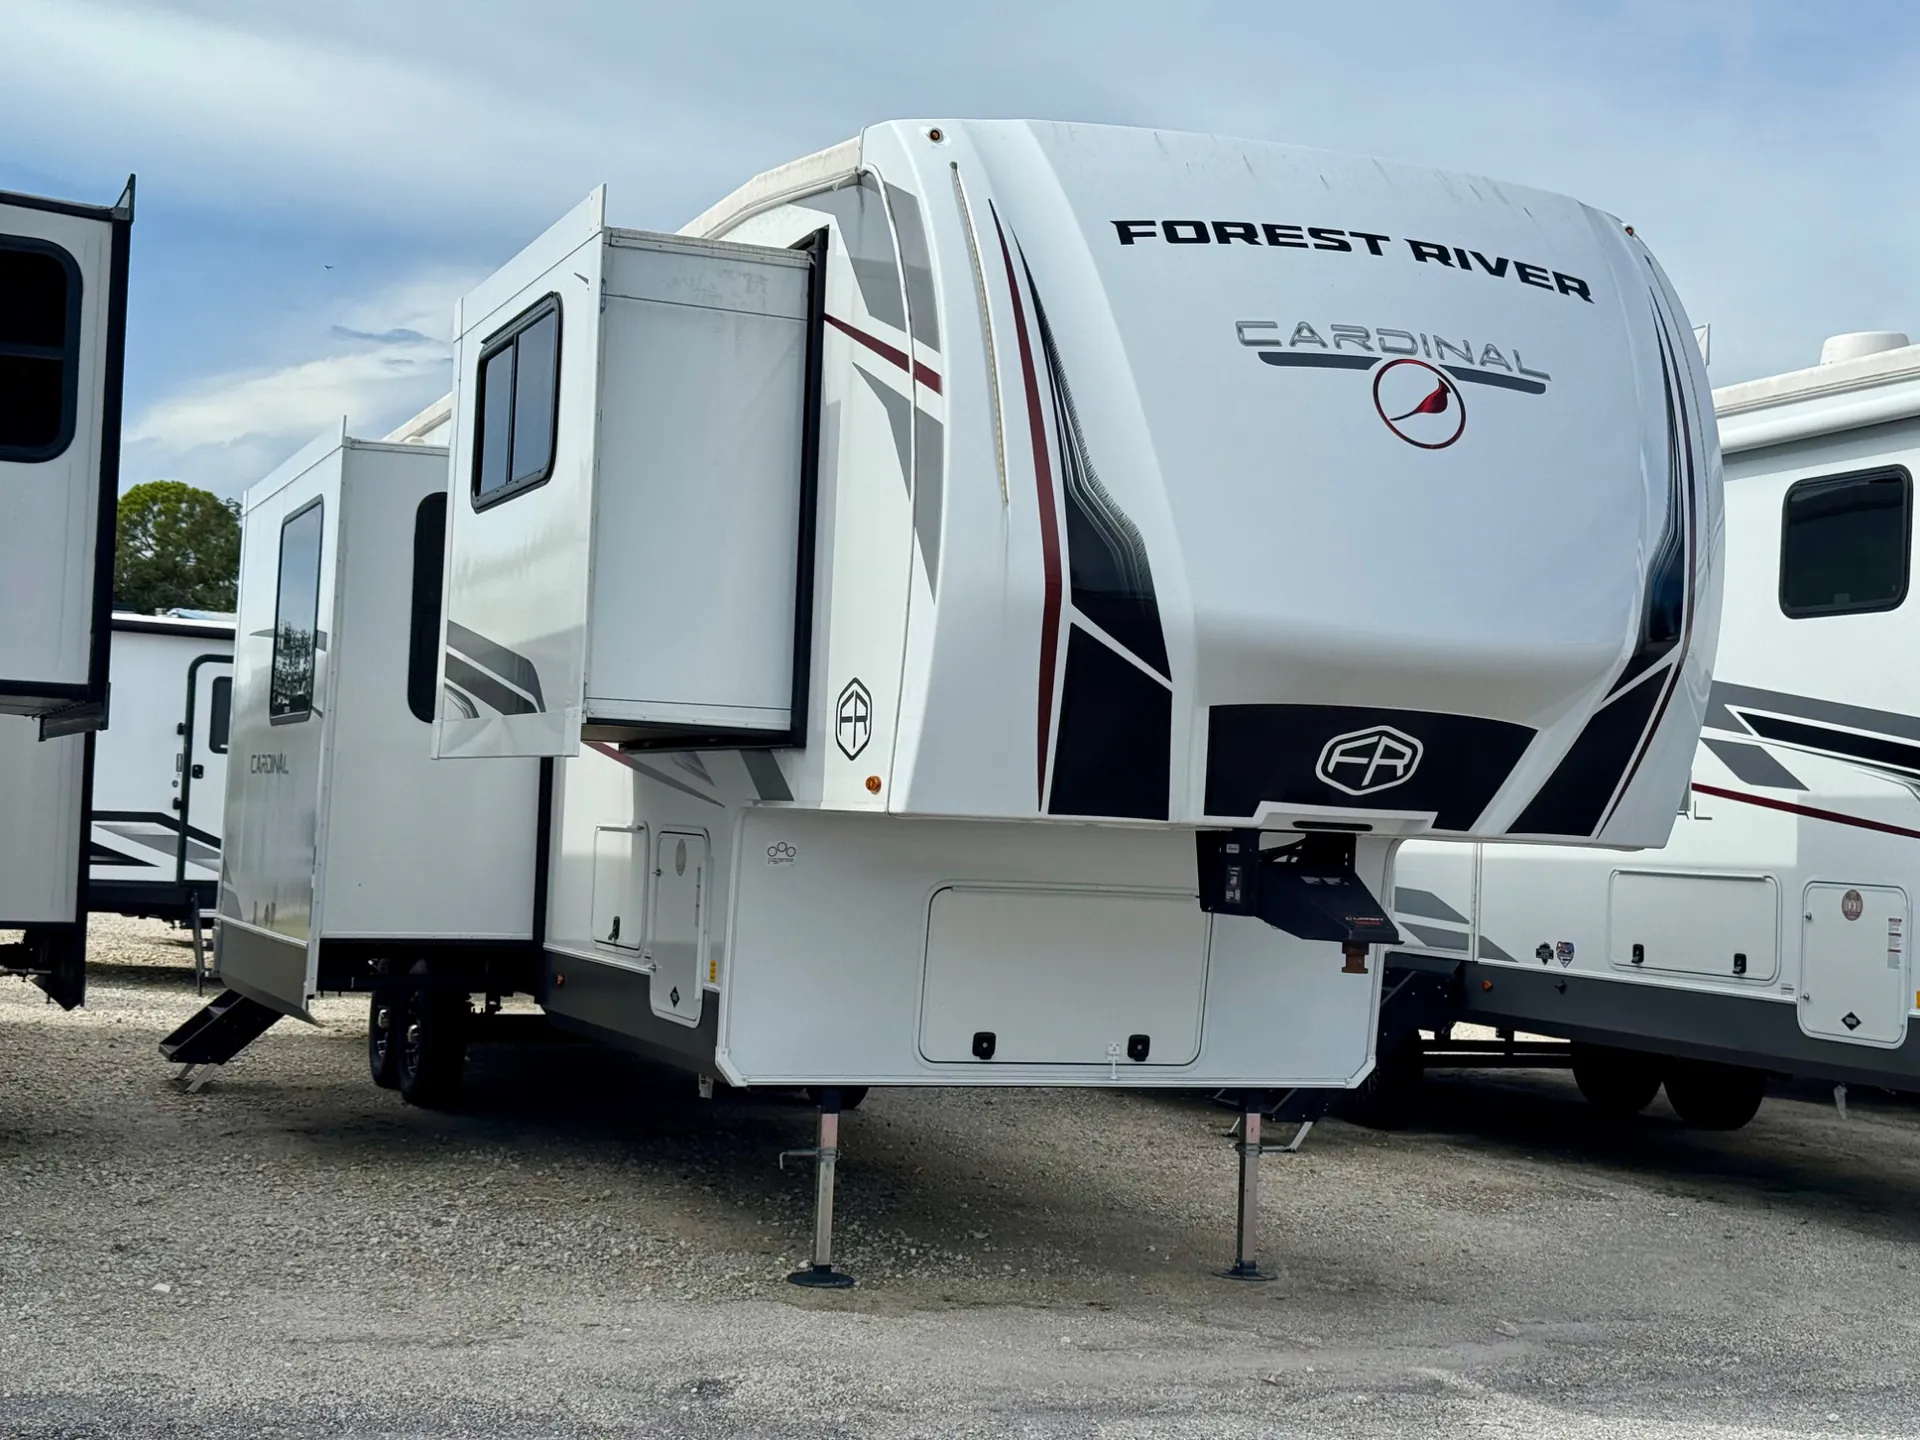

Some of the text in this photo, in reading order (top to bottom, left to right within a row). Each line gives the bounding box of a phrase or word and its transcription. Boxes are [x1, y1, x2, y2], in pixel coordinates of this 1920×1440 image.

[1110, 220, 1595, 304] FOREST RIVER
[1235, 320, 1551, 381] CARDINAL
[251, 753, 289, 774] CARDINAL
